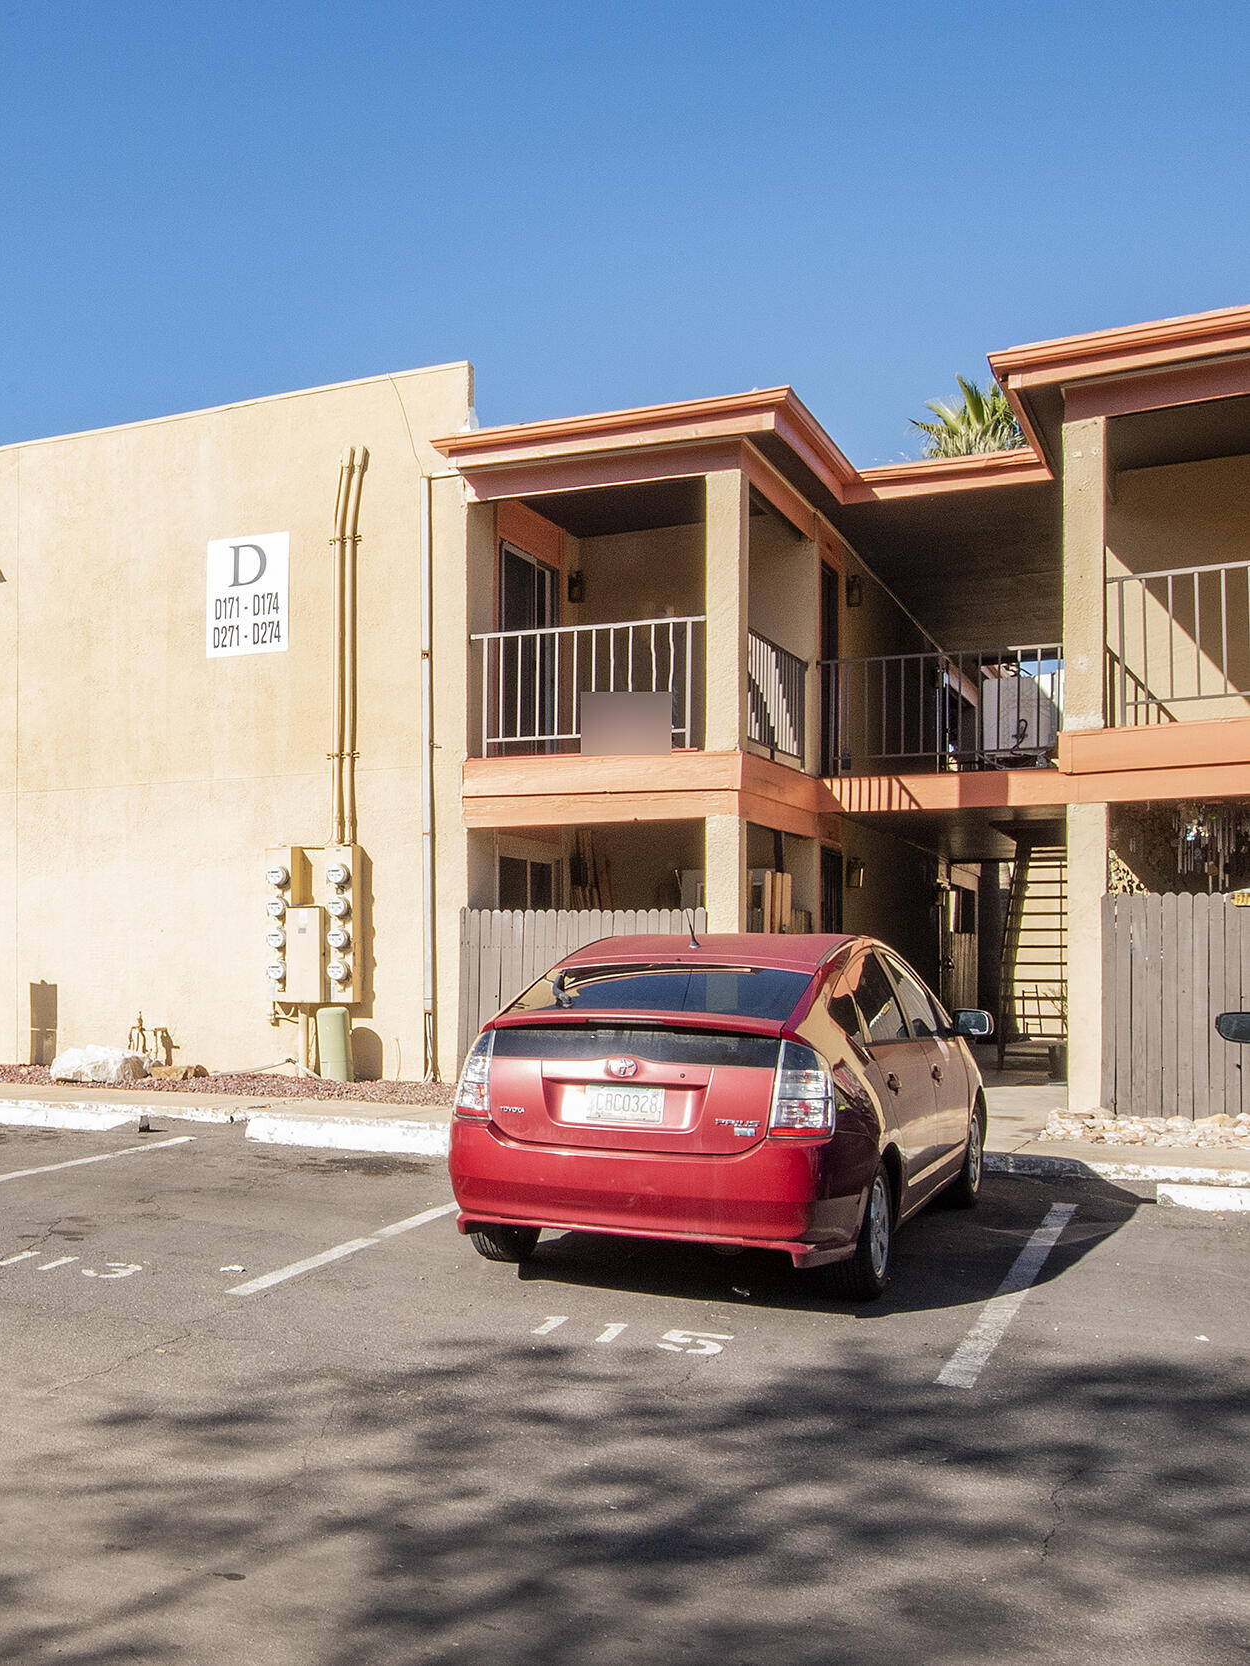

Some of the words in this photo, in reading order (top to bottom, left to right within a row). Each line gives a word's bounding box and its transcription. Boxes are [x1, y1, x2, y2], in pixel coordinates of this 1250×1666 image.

[228, 544, 267, 588] D
[215, 596, 240, 620] D171
[253, 592, 279, 616] D174
[213, 625, 240, 648] D271
[252, 621, 281, 645] D274
[530, 1315, 735, 1356] 115
